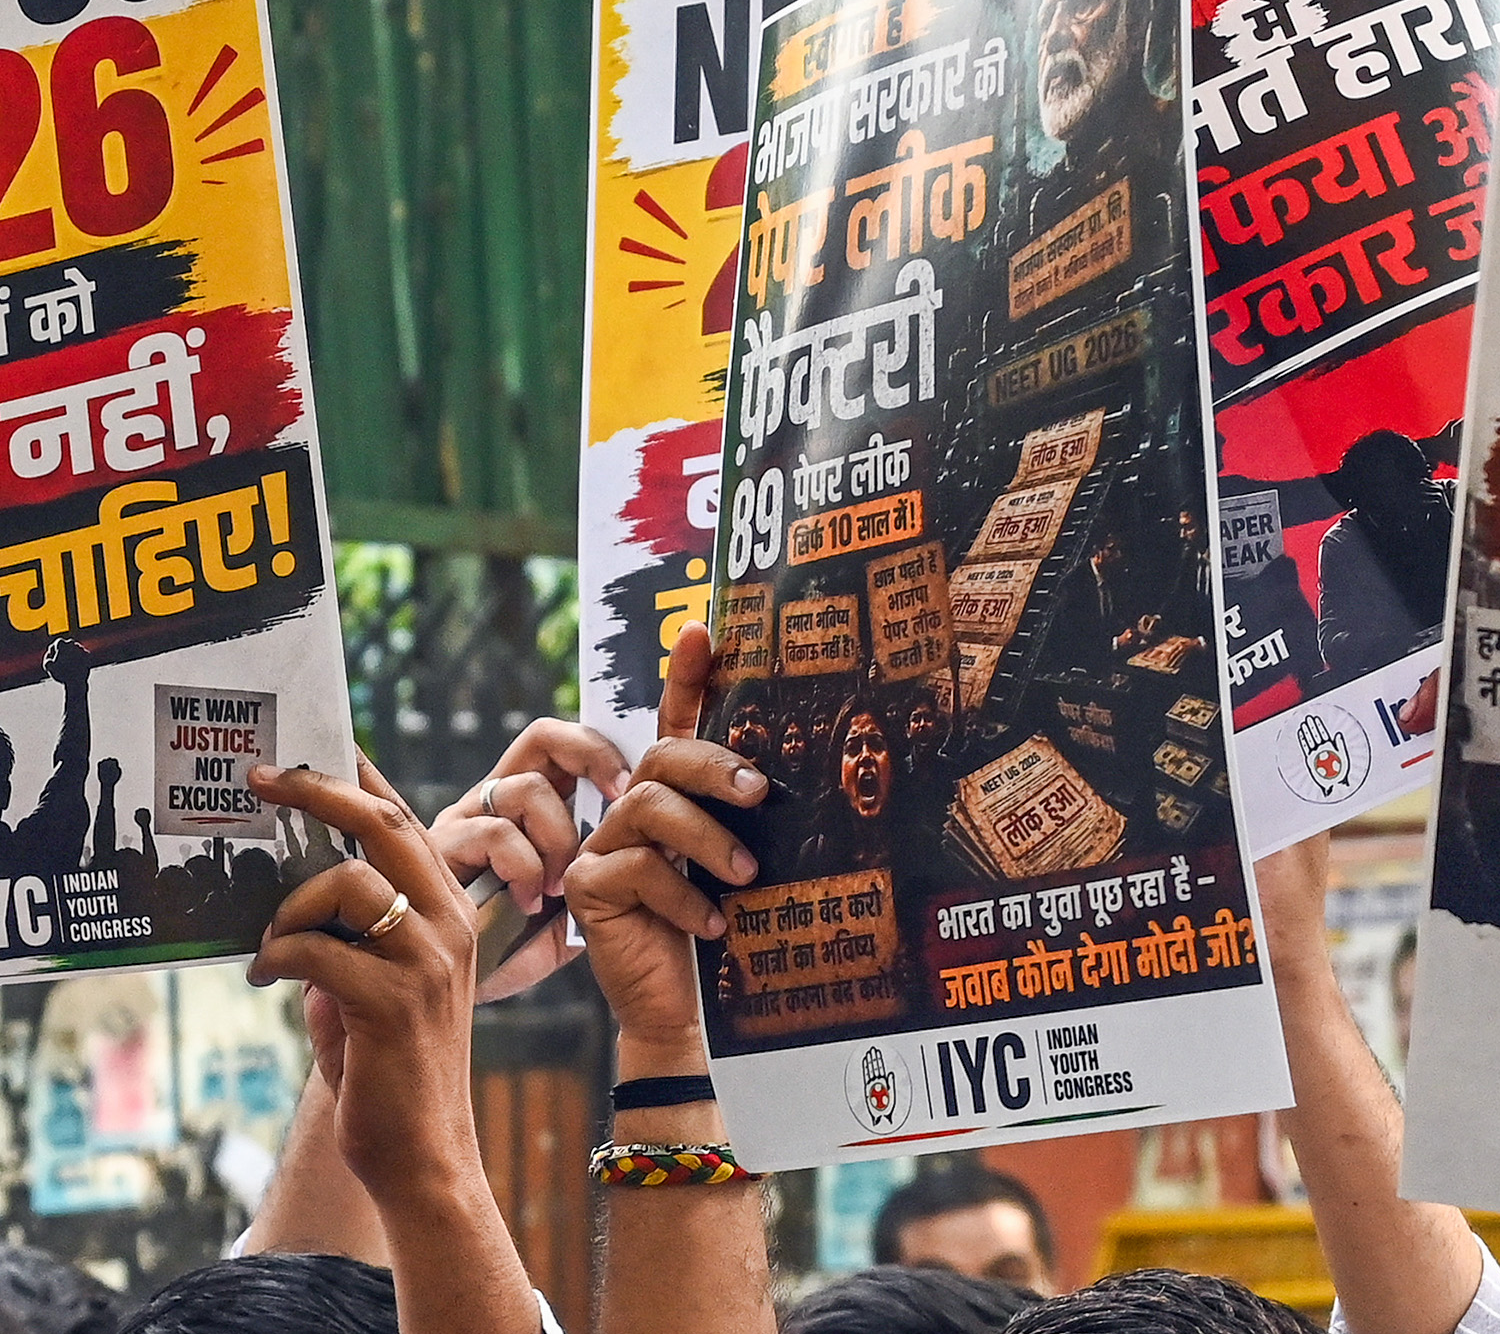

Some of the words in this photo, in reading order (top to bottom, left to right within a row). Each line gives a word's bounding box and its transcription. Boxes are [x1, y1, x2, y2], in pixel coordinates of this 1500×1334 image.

[802, 6, 874, 80] स्वागत
[755, 82, 850, 185] भाजपा
[850, 39, 970, 144] सरकार
[972, 38, 1008, 101] की
[746, 189, 834, 310] पेपर
[845, 128, 994, 271] लीक
[24, 267, 97, 344] को
[1050, 344, 1078, 381] UG
[1085, 320, 1138, 369] 2026
[792, 453, 846, 511] पेपर
[849, 432, 913, 498] लीक
[727, 466, 785, 580] 89
[793, 521, 824, 559] सिर्फ
[829, 513, 852, 549] 10
[857, 509, 890, 542] साल
[894, 499, 917, 533] में!
[980, 597, 1008, 621] हुआ
[169, 696, 201, 722] WE
[205, 698, 262, 725] WANT
[169, 726, 262, 757] JUSTICE,
[195, 757, 235, 782] NOT
[980, 774, 1004, 796] NEET
[168, 786, 262, 814] EXCUSES!
[1001, 805, 1045, 847] लीक
[1039, 782, 1078, 828] हुआ
[62, 869, 118, 894] INDIAN
[66, 892, 118, 918] YOUTH
[937, 898, 995, 941] भारत
[1000, 893, 1032, 931] का
[1036, 884, 1081, 937] युवा
[1087, 876, 1123, 928] पूछ
[1127, 868, 1166, 909] रहा
[1169, 855, 1192, 902] है
[69, 916, 152, 942] CONGRESS
[735, 903, 771, 937] पेपर
[775, 896, 814, 932] लीक
[847, 882, 882, 920] करो
[939, 960, 1009, 1011] जवाब
[1012, 940, 1074, 999] कौन
[1077, 932, 1131, 987] देगा
[1132, 915, 1198, 976] मोदी
[1202, 908, 1257, 968] जी?
[1046, 1023, 1099, 1051] INDIAN
[1049, 1053, 1099, 1076] YOUTH
[937, 1031, 1031, 1118] IYC
[1053, 1071, 1133, 1102] CONGRESS
